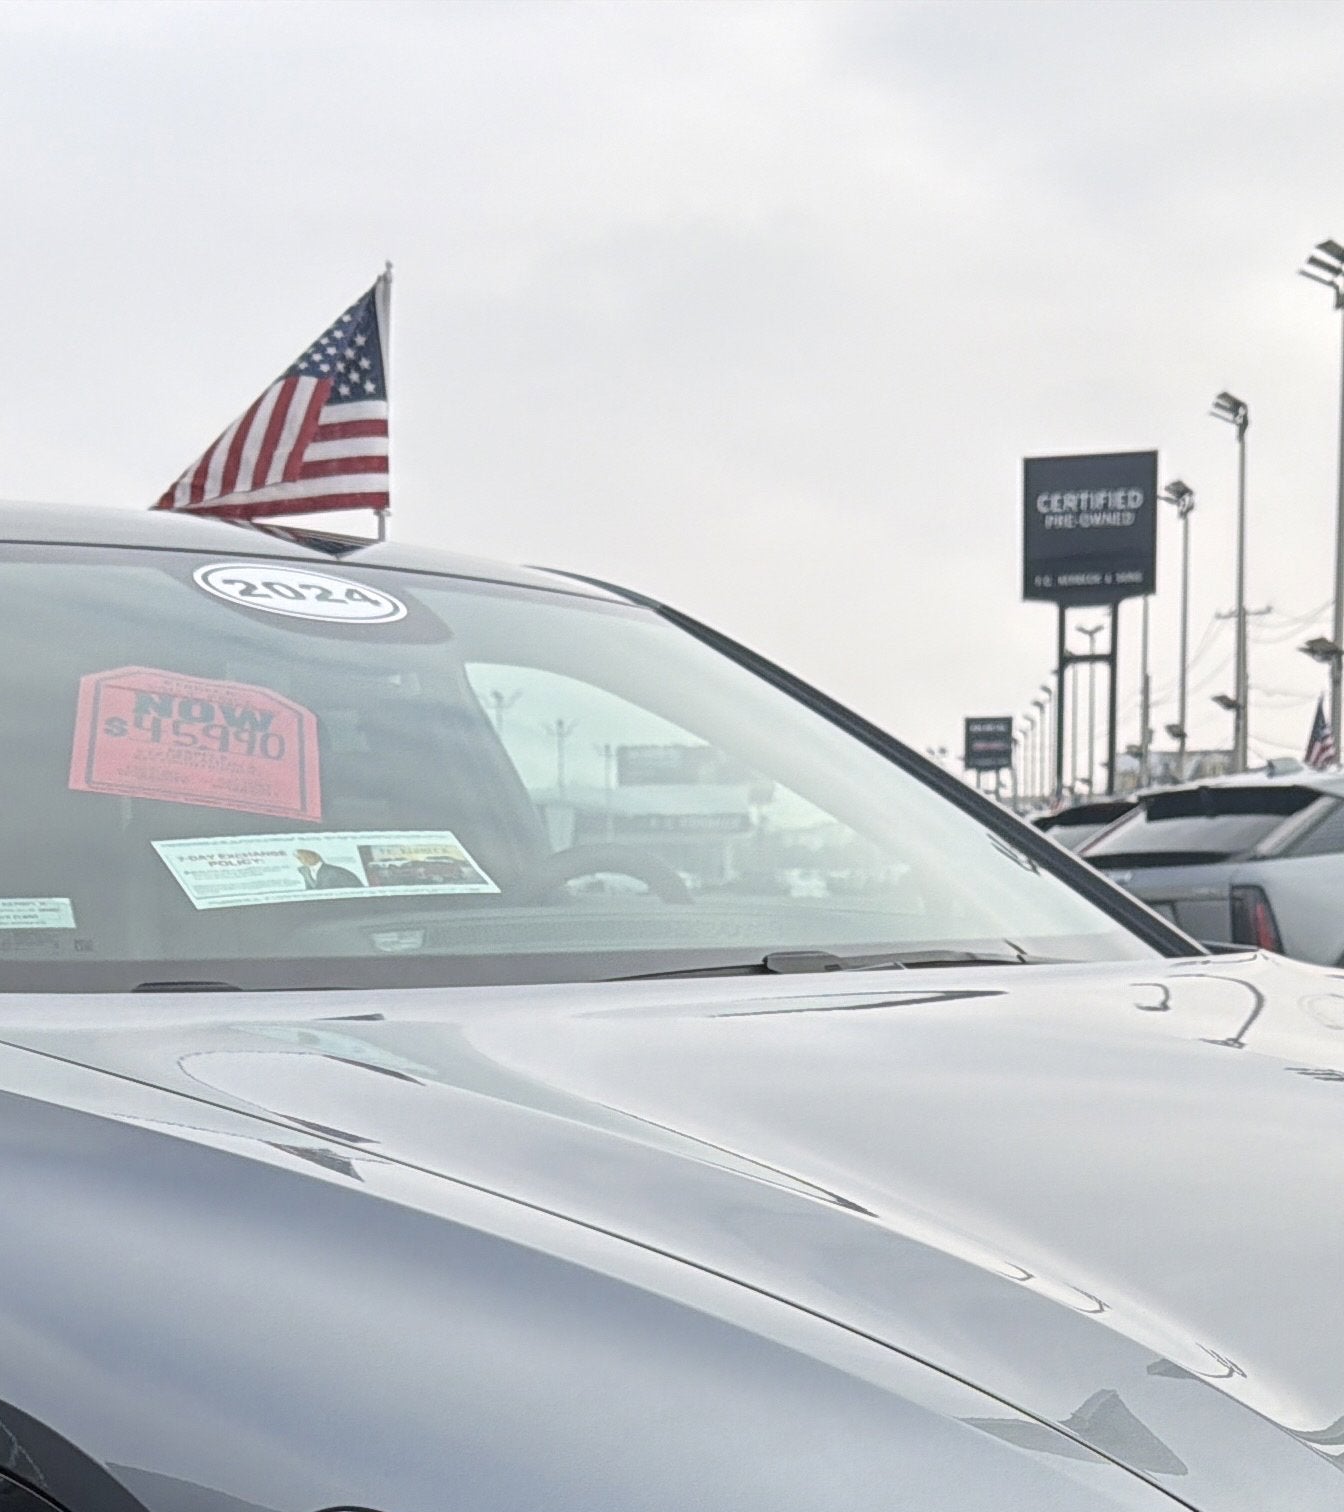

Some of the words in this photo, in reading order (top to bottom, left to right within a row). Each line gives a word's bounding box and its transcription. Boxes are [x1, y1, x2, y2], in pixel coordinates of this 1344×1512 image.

[1037, 488, 1144, 513] CERTIFIED
[222, 579, 383, 606] 2024
[133, 691, 275, 733] NOW
